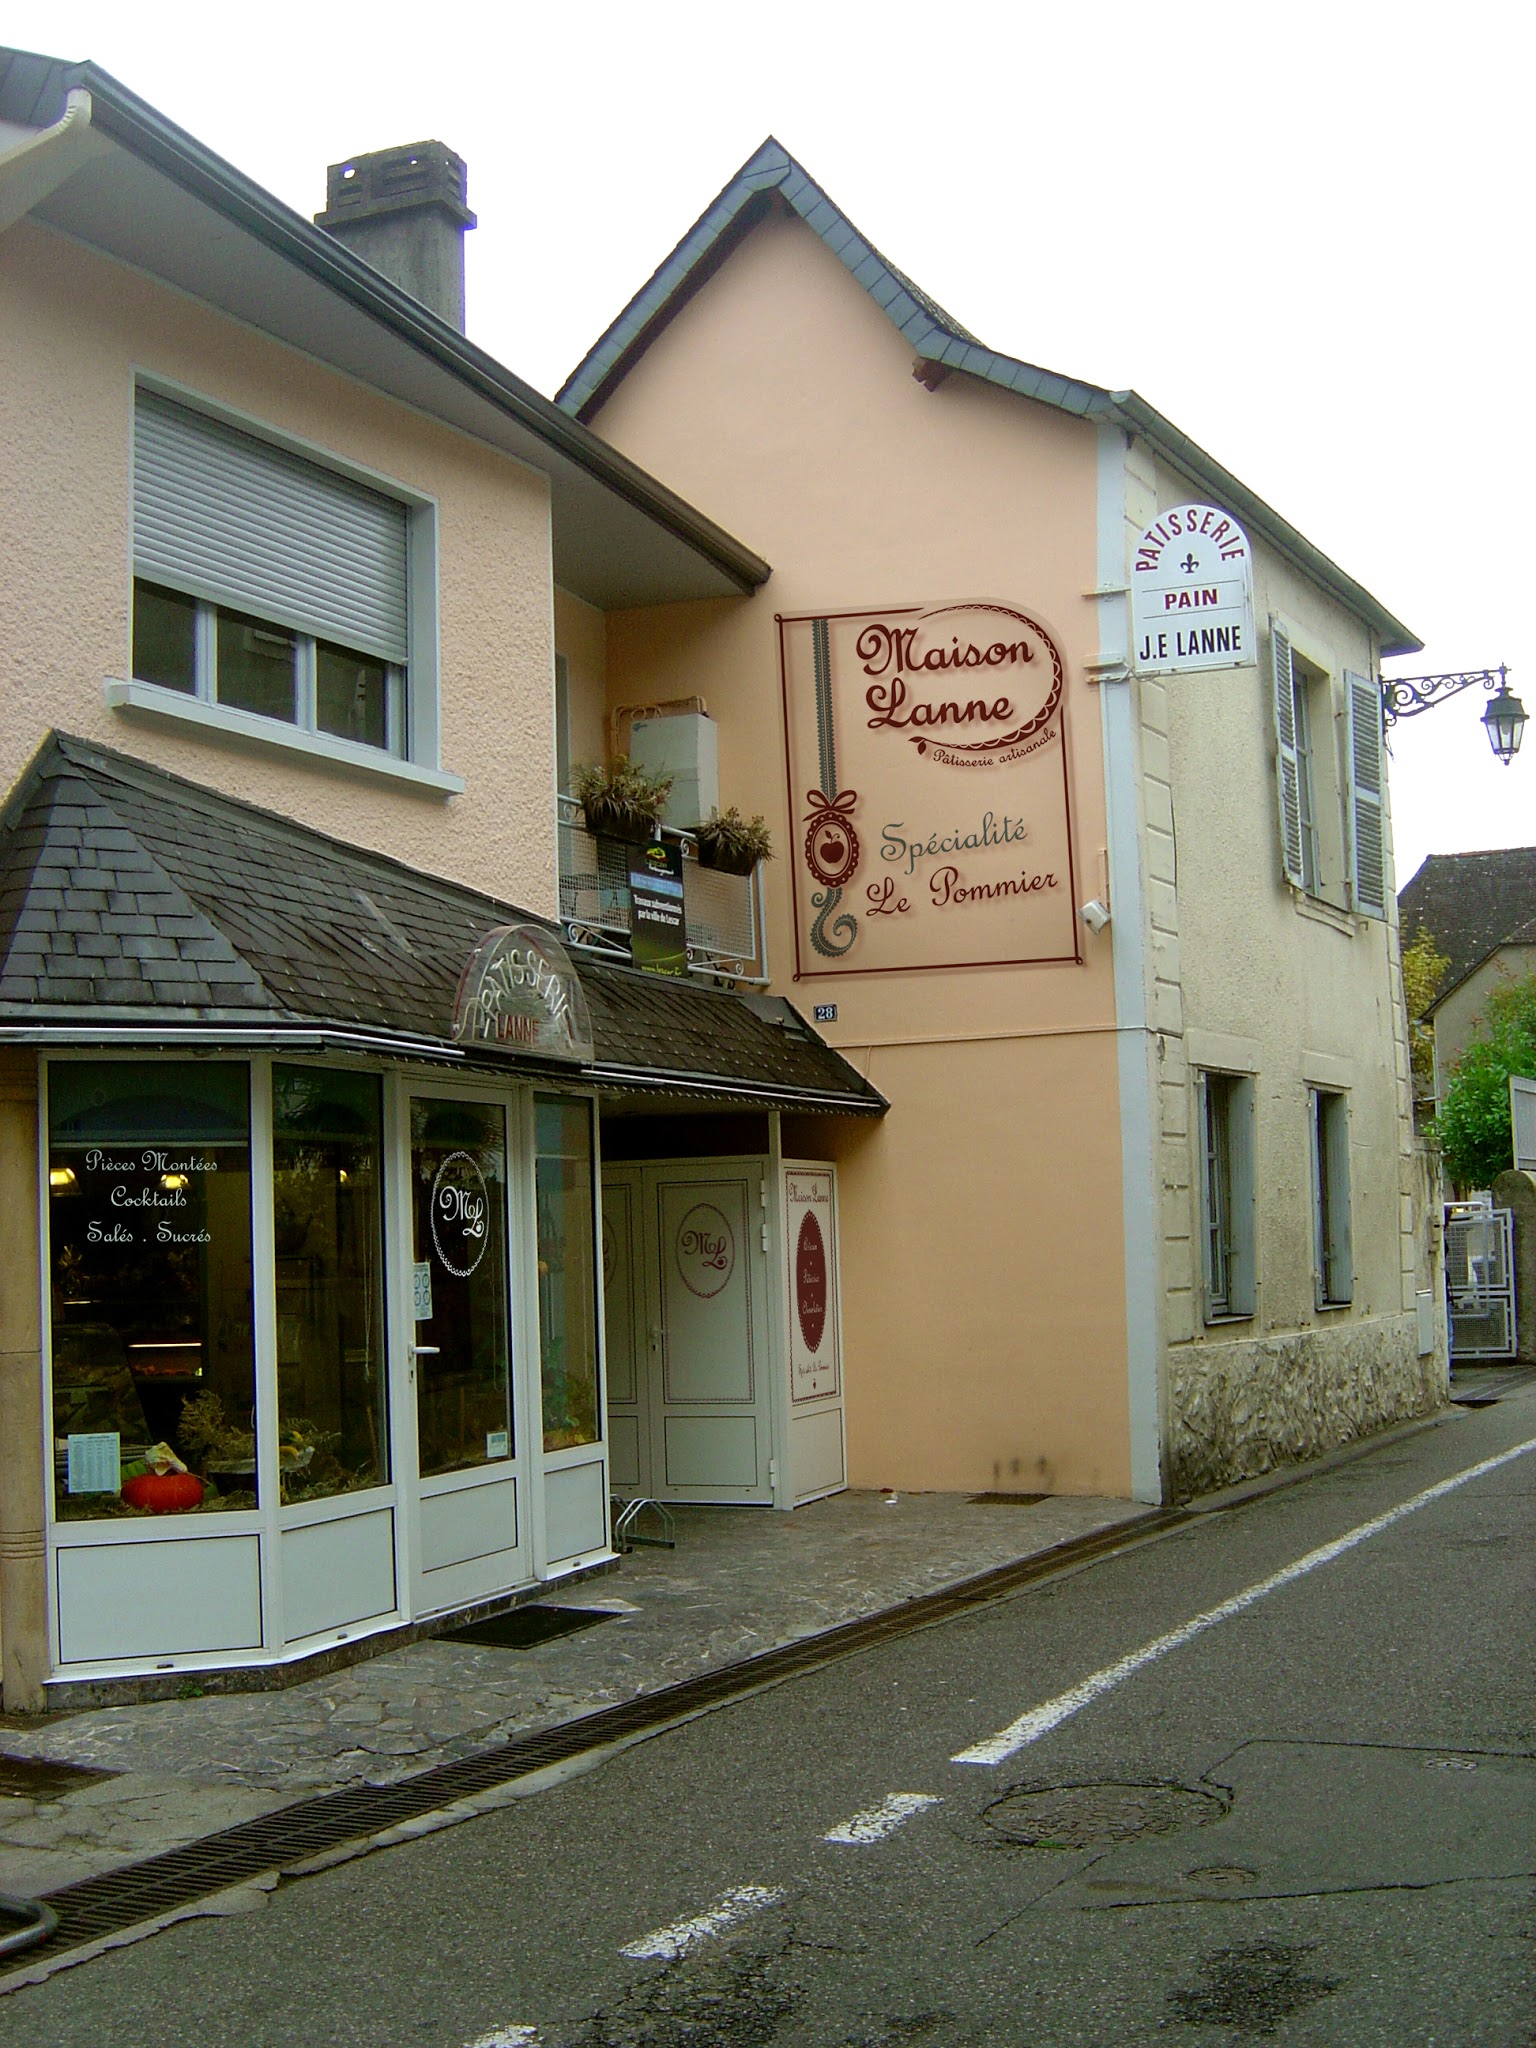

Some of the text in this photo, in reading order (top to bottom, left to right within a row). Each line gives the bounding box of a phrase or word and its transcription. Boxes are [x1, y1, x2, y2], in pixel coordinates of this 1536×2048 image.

[1135, 508, 1246, 573] PATISSERIE
[1164, 588, 1218, 610] PAIN
[856, 623, 1034, 676] Maison
[1139, 625, 1242, 661] J.E LANNE
[865, 677, 1014, 729] Lanne
[933, 728, 1056, 767] Pâtisserie artisanale
[880, 811, 1028, 875] Spécialité
[865, 866, 1058, 917] Le Pommier
[817, 1006, 833, 1020] 28
[85, 1149, 218, 1171] Pièces Montées
[110, 1185, 187, 1207] Cocktails
[86, 1220, 134, 1243] Salés
[156, 1220, 211, 1243] Sucrés
